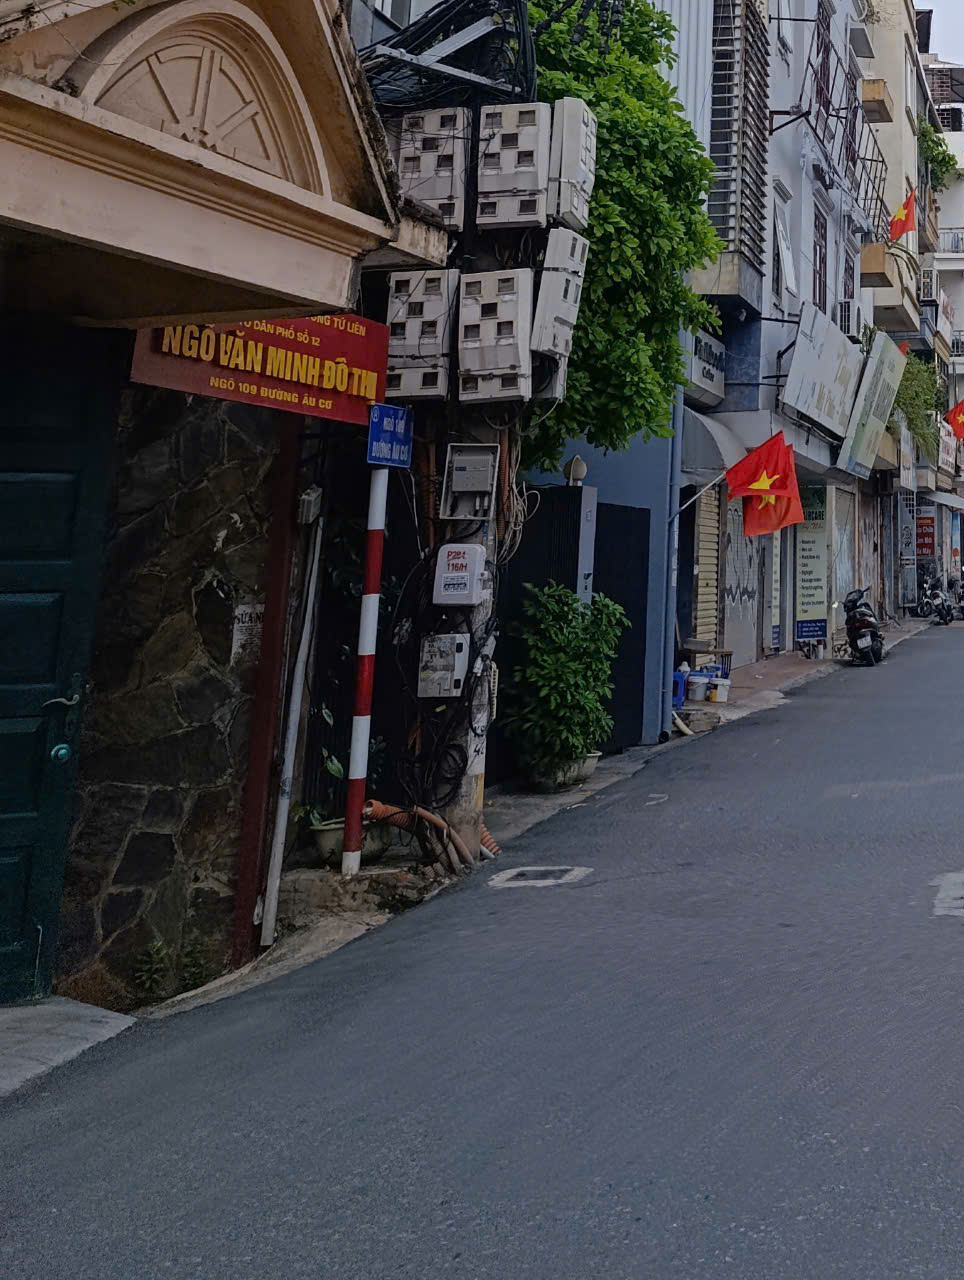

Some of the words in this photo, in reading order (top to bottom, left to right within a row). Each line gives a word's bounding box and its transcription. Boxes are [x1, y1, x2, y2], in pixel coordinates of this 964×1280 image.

[253, 319, 274, 334] DÂN
[275, 324, 295, 339] PHỐ
[311, 336, 320, 346] 12
[333, 317, 346, 330] TỨ
[347, 321, 366, 336] LIÊN
[162, 324, 216, 361] NGÕ
[220, 330, 263, 373] VĂN
[266, 345, 320, 387] MINH
[322, 357, 349, 392] ĐÔ
[351, 367, 378, 405] THỊ
[209, 376, 235, 390] NGÕ
[238, 383, 257, 395] 109
[260, 386, 299, 403] ĐƯỜNG
[302, 393, 316, 407] ÂU
[318, 398, 333, 409] CƠ
